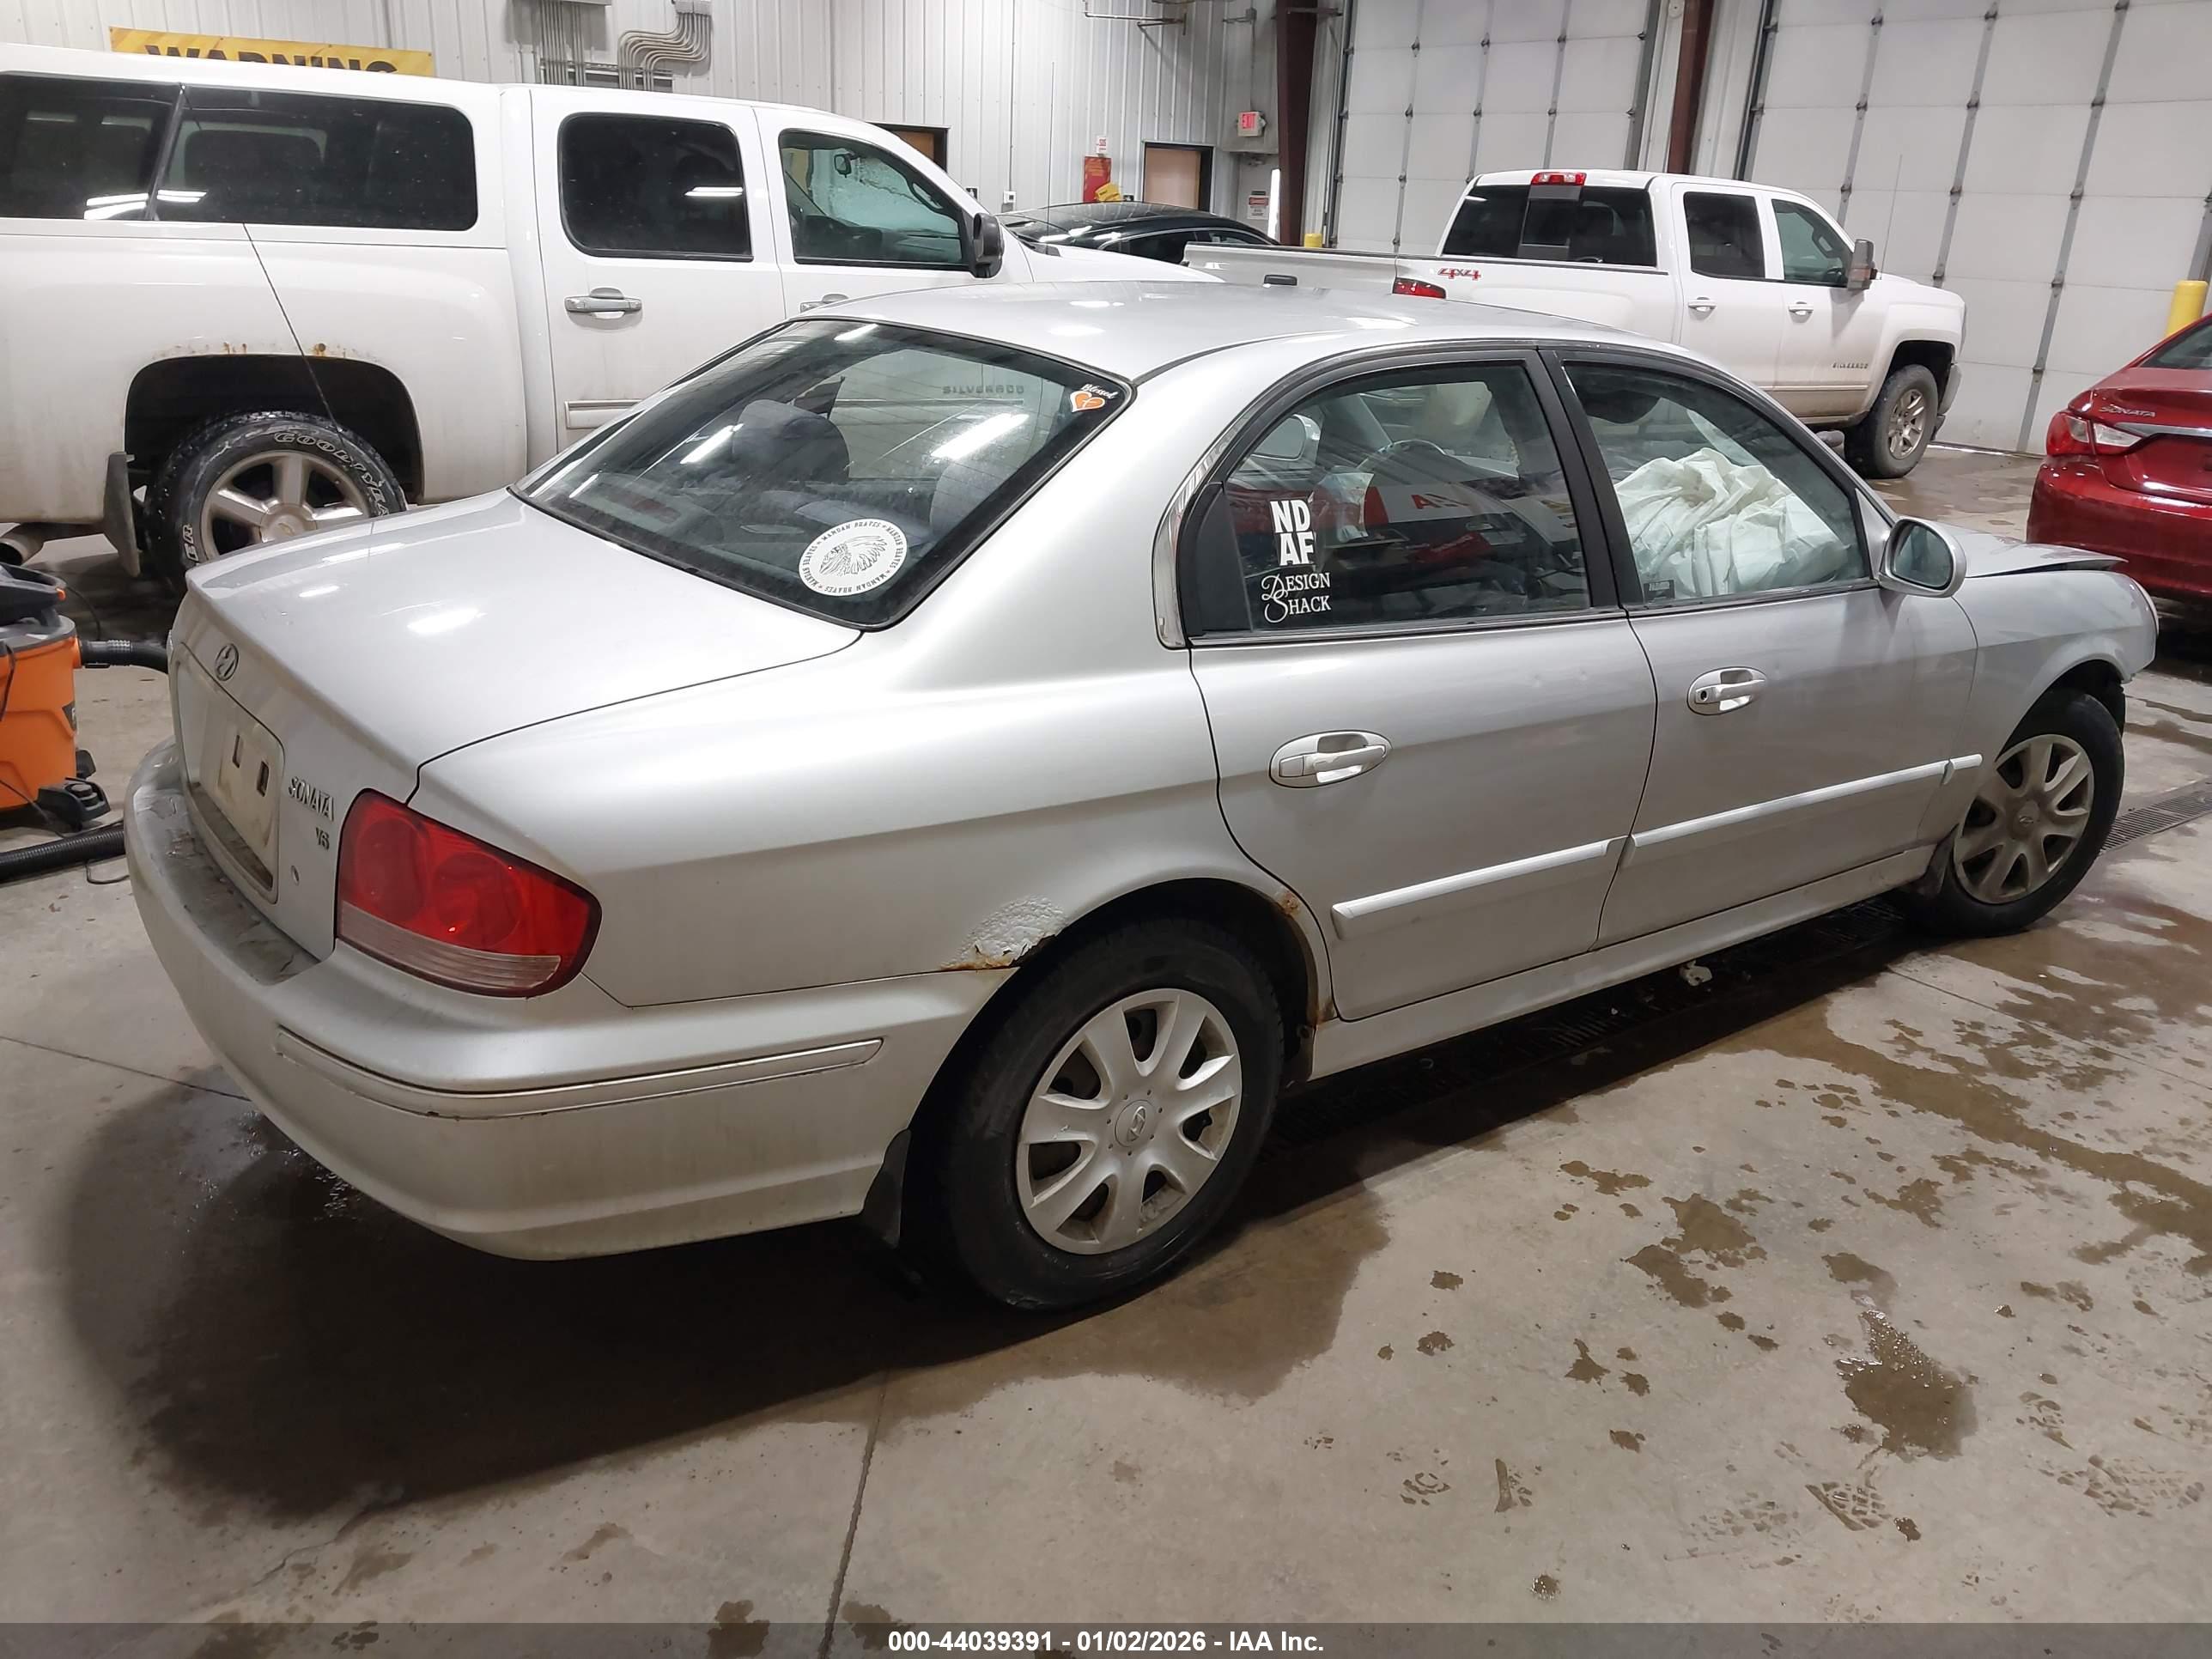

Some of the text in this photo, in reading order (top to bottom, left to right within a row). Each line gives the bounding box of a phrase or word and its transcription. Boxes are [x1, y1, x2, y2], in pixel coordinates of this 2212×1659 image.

[942, 386, 1024, 395] SILVERADO
[1080, 384, 1119, 399] Blessed
[274, 432, 390, 516] GOODYEA
[1270, 499, 1311, 533] ND
[821, 525, 851, 541] MANDAN
[1279, 531, 1315, 566] AF
[1261, 573, 1331, 601] DESIGN
[1264, 590, 1331, 623] SHACK
[289, 776, 335, 822] SONATA
[315, 826, 330, 850] V6
